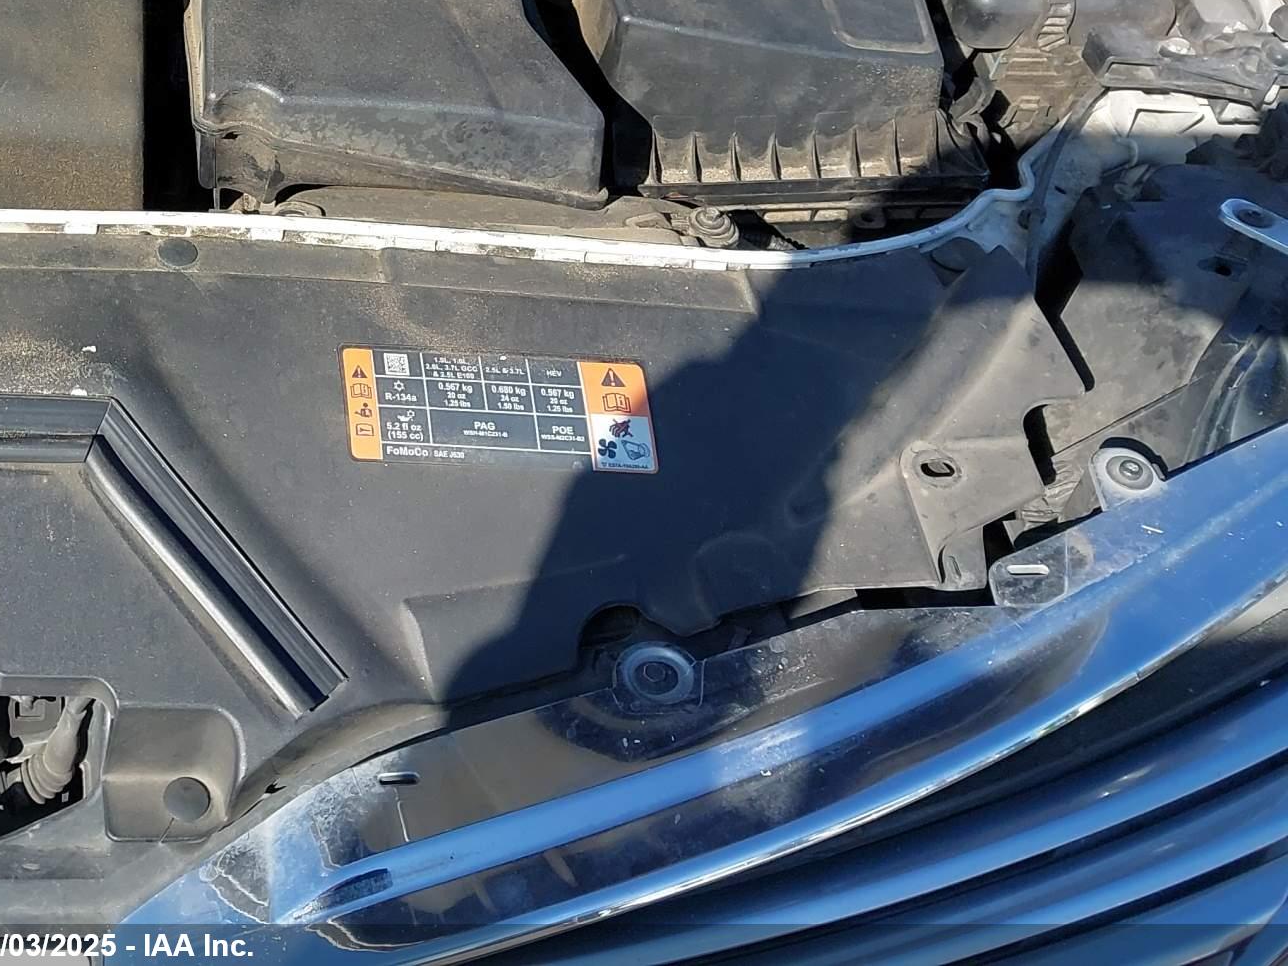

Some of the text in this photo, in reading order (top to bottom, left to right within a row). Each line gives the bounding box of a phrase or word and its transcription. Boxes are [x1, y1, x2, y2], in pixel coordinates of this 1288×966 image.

[438, 382, 473, 394] 0.567 kg
[491, 385, 527, 396] 0.680 kg
[385, 392, 417, 402] R-134a
[540, 388, 575, 400] 0.567 kg
[443, 399, 472, 408] 1.25 lbs
[549, 397, 559, 405] 20
[497, 402, 525, 411] 1.50 lbs
[562, 405, 573, 413] lbs
[386, 422, 400, 430] 5.2
[401, 422, 409, 430] fl
[473, 421, 496, 431] PAG
[551, 425, 574, 435] POE
[387, 431, 424, 442] (155 cc)
[386, 445, 429, 457] FoMoCo
[433, 450, 449, 458] SAE
